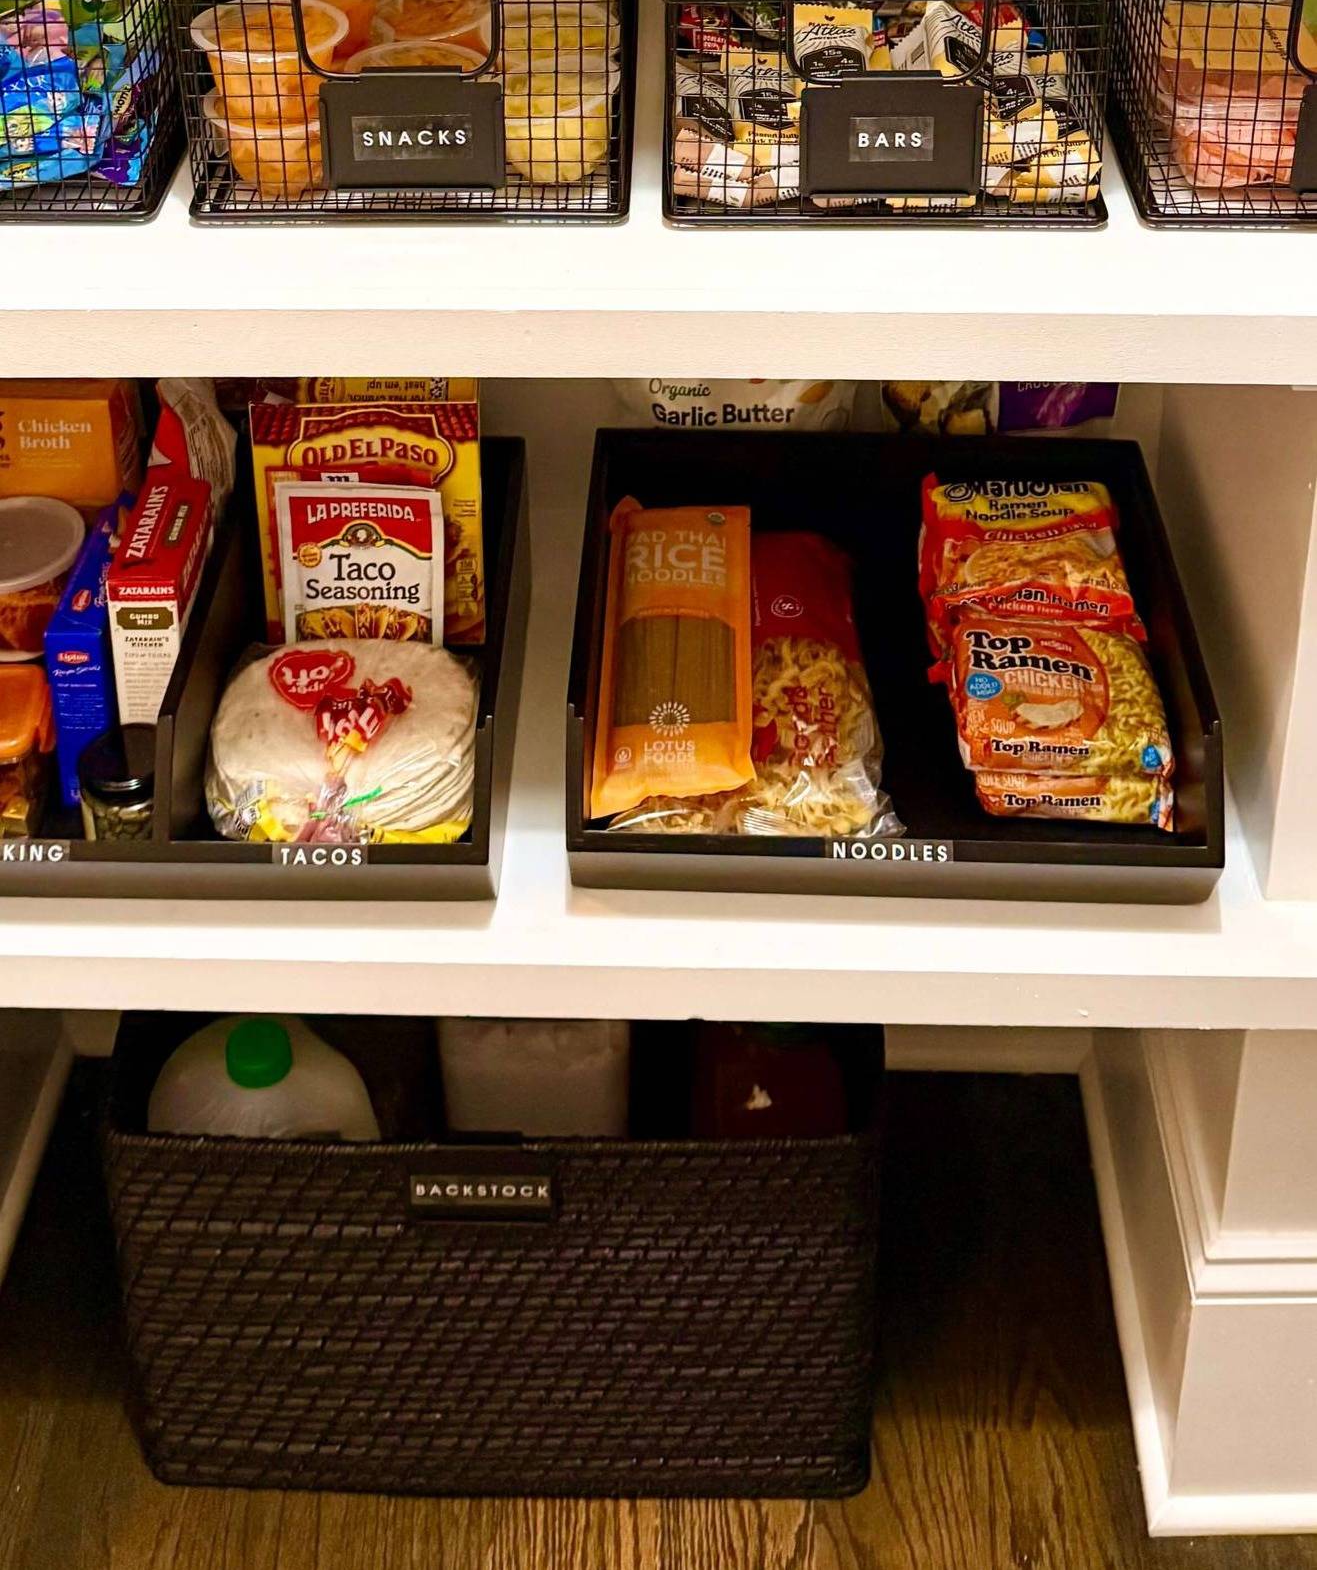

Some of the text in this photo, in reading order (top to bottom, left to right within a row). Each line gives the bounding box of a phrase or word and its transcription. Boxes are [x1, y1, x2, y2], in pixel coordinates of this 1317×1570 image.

[362, 130, 466, 146] SNACKS
[858, 132, 922, 148] BARS
[649, 378, 711, 401] Organic
[652, 403, 795, 426] Garlic Butter
[18, 418, 92, 433] Chicken
[20, 435, 71, 449] Broth
[302, 444, 346, 466] OLD
[348, 439, 378, 459] EL
[307, 502, 415, 524] LA PREFERIDA
[989, 499, 1048, 511] Ramen
[966, 508, 1075, 521] Noodle Soup
[984, 529, 1059, 541] Chicken
[329, 553, 396, 581] Taco
[305, 579, 420, 604] Seasoning
[964, 630, 1033, 655] Top
[970, 649, 1095, 682] Ramen
[644, 740, 695, 752] LOTUS
[992, 740, 1089, 756] Top Ramen
[644, 751, 695, 764] FOODS
[1004, 794, 1100, 807] Top Ramen
[3, 844, 64, 862] KING
[280, 848, 362, 864] TACOS
[832, 842, 948, 862] NOODLES
[416, 1184, 549, 1197] BACKSTOCK
